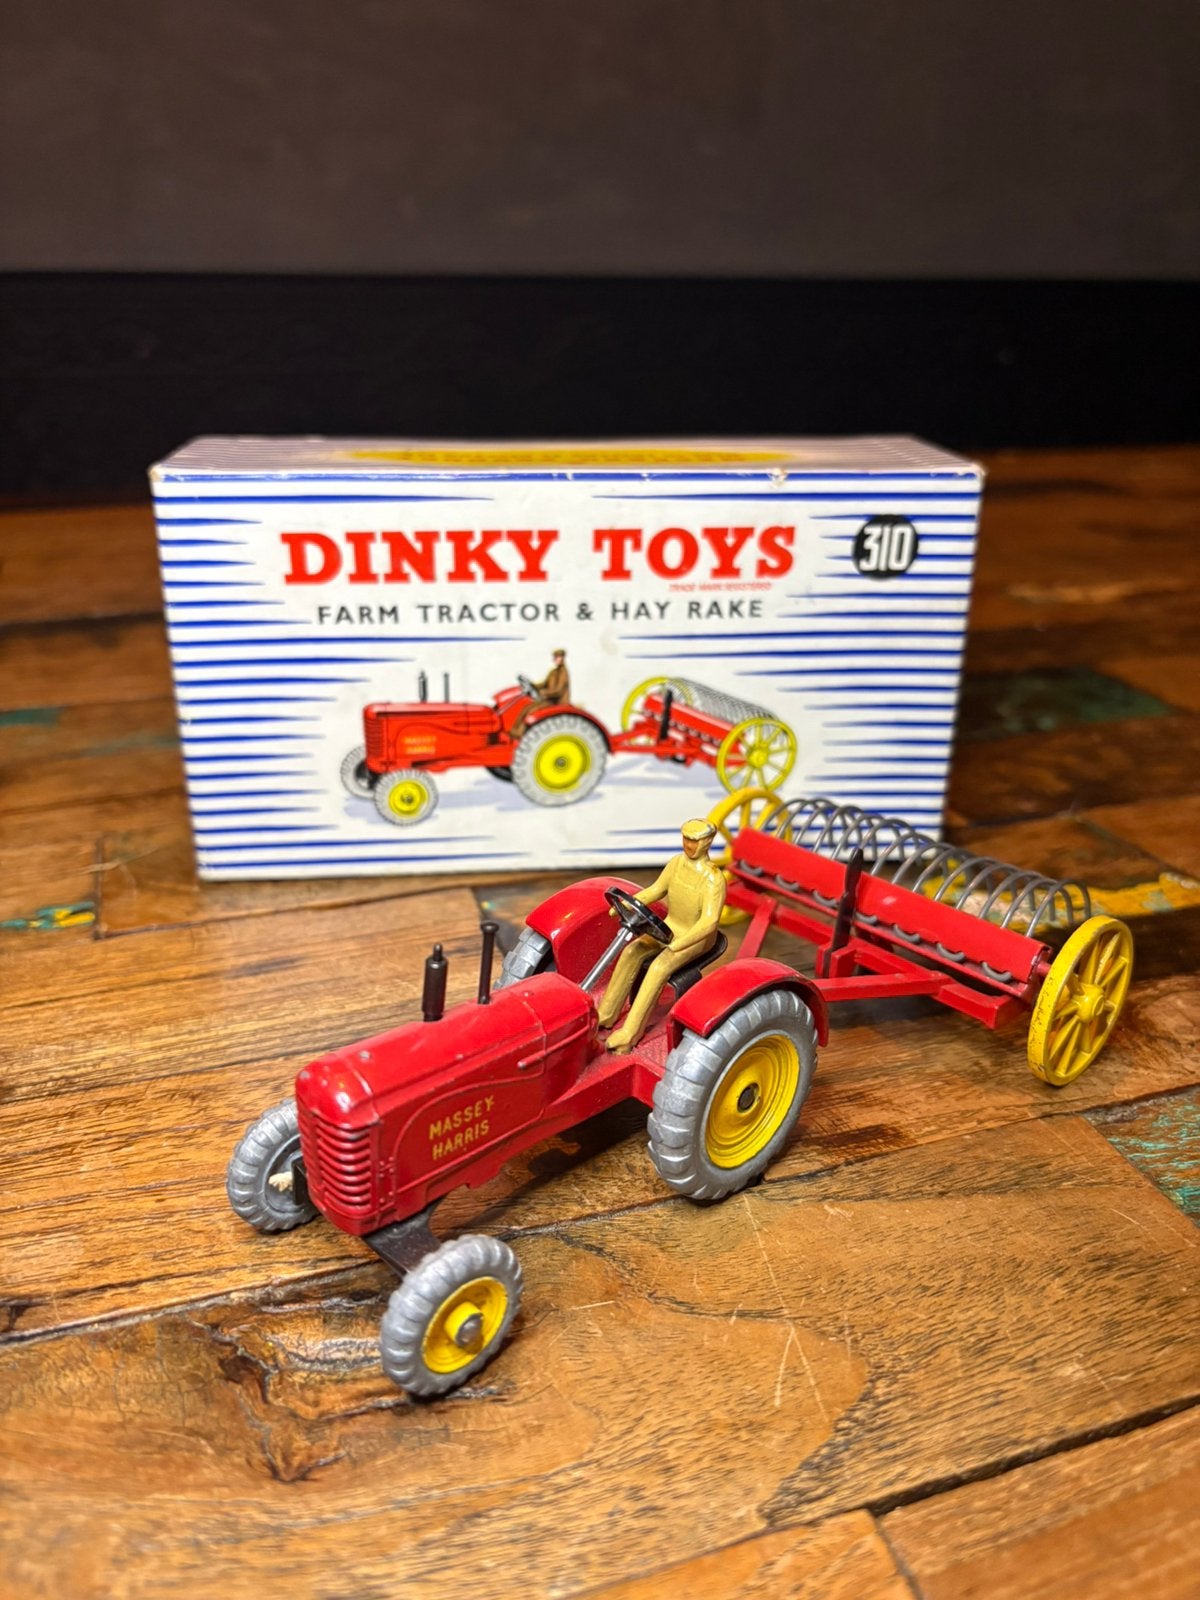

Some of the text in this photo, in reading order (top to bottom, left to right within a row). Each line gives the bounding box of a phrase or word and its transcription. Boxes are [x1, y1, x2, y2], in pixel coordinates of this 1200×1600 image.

[280, 526, 796, 585] DINKY TOYS
[859, 525, 913, 571] 310
[317, 600, 763, 625] FARM TRACTOR & HAY RAKE
[428, 1095, 495, 1140] MASSEY
[432, 1119, 490, 1161] HARRIS
